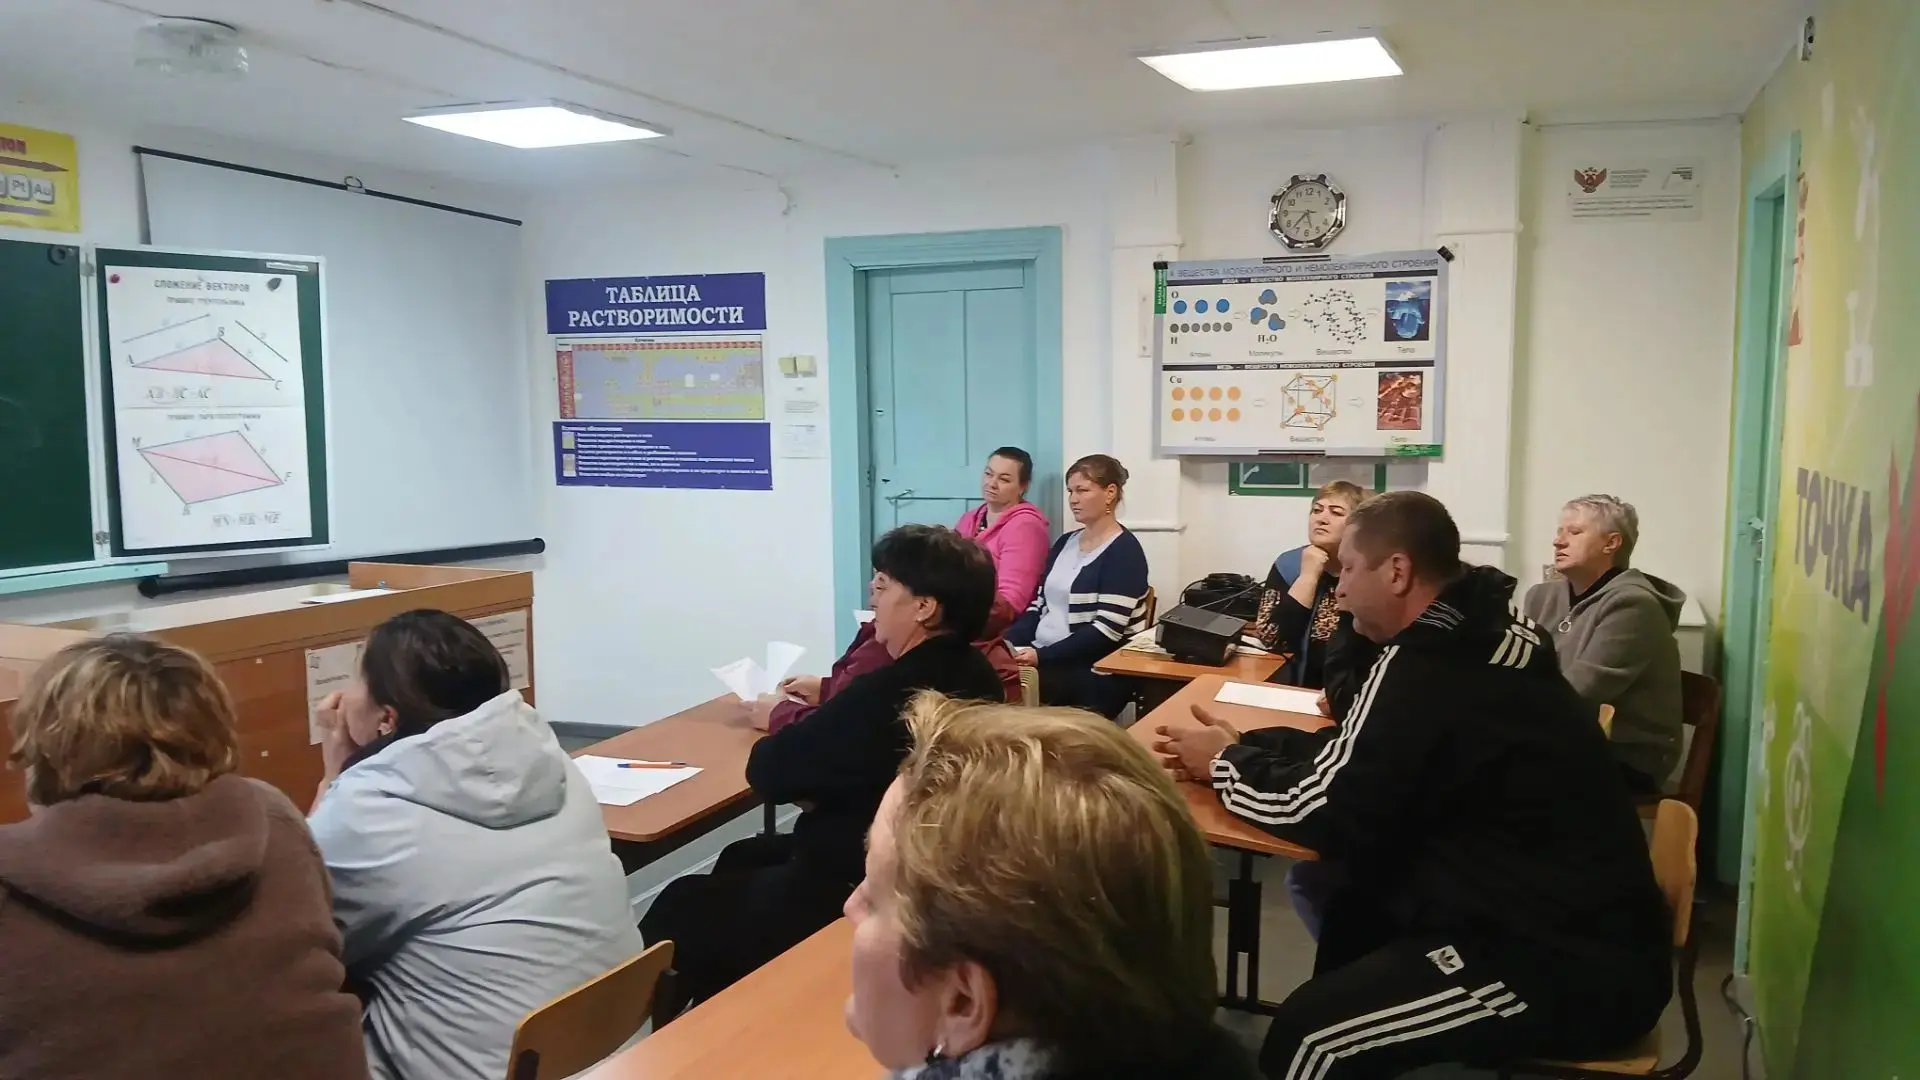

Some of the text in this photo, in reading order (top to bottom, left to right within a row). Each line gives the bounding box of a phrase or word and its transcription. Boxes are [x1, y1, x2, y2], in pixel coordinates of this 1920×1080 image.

[1305, 188, 1314, 196] 12
[1324, 197, 1330, 205] 2
[1304, 229, 1310, 237] 6
[606, 284, 702, 304] ТАБЛИЦА
[568, 306, 745, 327] РАСТВОРИМОСТИ
[1795, 467, 1872, 625] ТОЧКА
